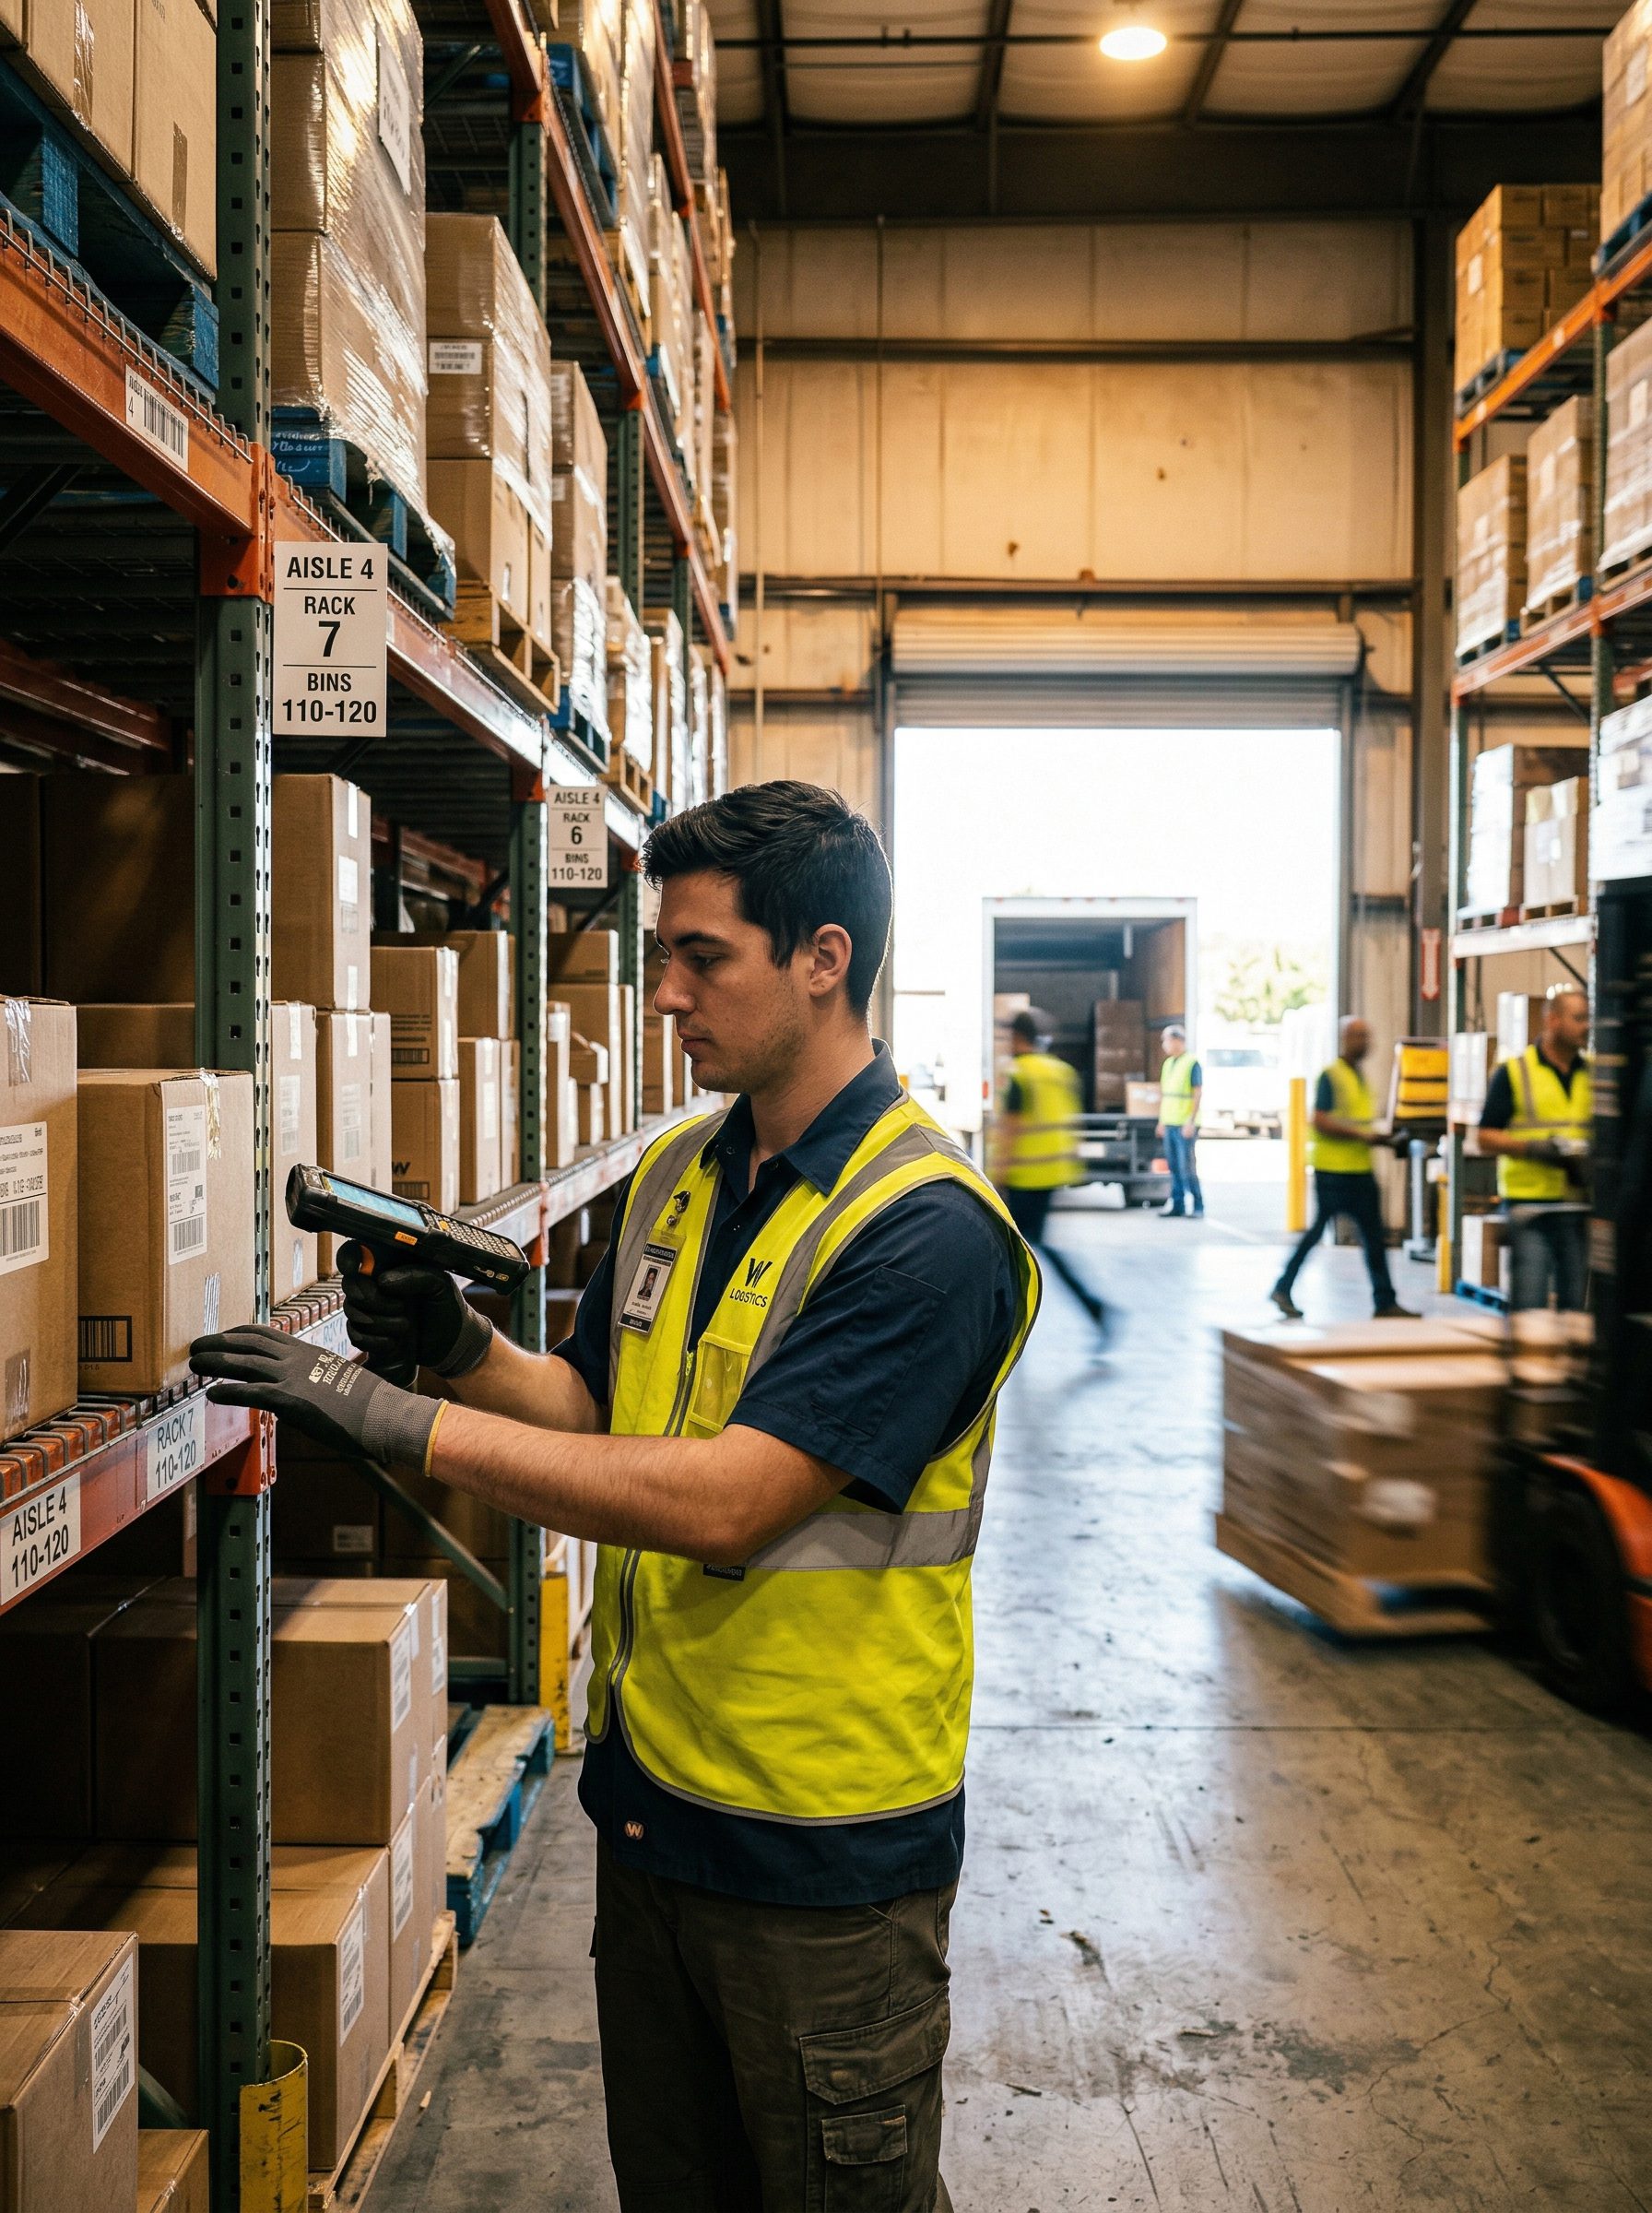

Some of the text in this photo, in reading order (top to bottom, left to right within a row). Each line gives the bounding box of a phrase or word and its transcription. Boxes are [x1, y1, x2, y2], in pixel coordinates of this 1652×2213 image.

[287, 556, 373, 580] AISLE 4
[304, 596, 355, 615] RACK
[318, 621, 340, 657] 7
[307, 672, 351, 692] BINS
[282, 699, 376, 723] 110-120
[554, 792, 600, 804] AISLE 4
[563, 812, 590, 822] RACK
[572, 825, 583, 845] 6
[565, 853, 589, 864] BINS
[552, 868, 602, 881] 110-120
[158, 1407, 194, 1454] RACK 7
[156, 1439, 196, 1489] 110-120
[12, 1485, 67, 1546] AISLE 4
[12, 1524, 69, 1588] 110-120
[626, 1822, 643, 1837] W
